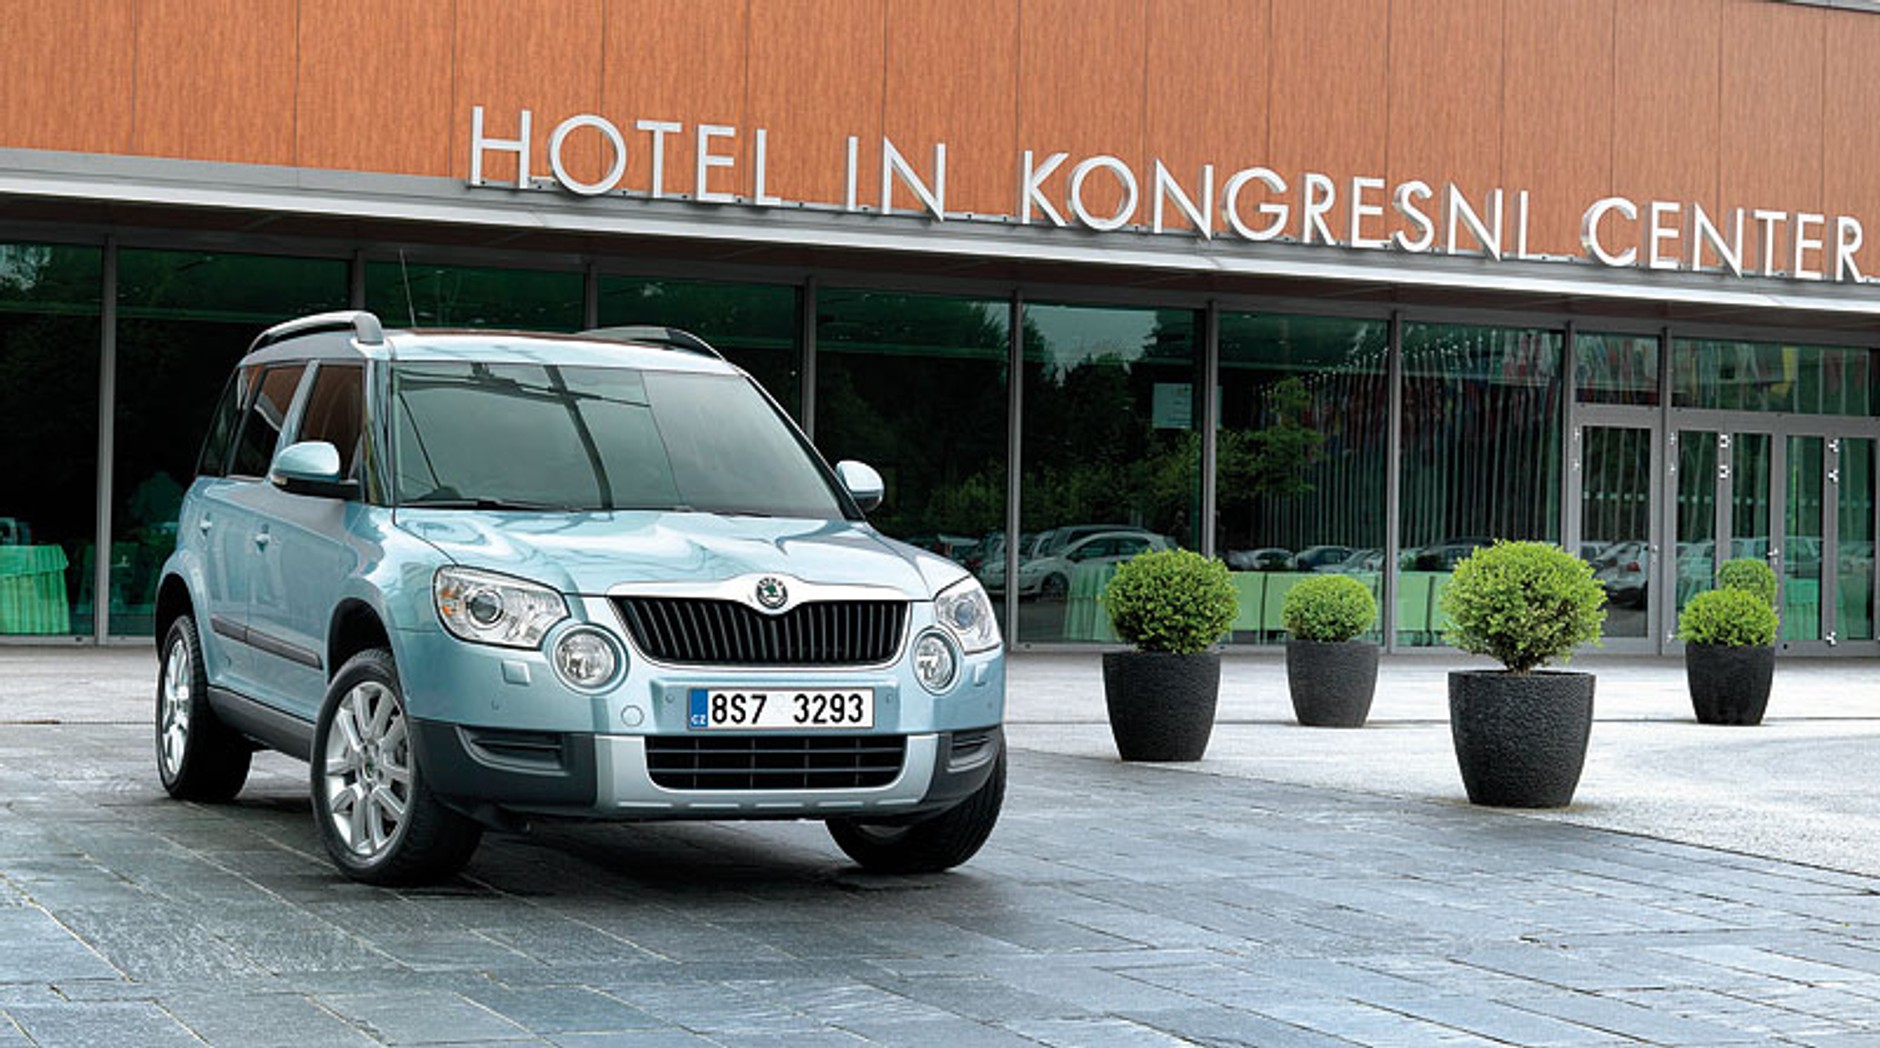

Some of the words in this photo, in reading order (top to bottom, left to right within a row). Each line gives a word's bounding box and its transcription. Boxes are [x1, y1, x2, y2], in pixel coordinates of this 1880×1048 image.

[471, 105, 781, 206] HOTEL
[846, 135, 946, 222] IN
[1584, 197, 1865, 284] CENTER
[690, 714, 706, 726] CZ
[712, 693, 768, 725] 8S7
[793, 693, 864, 724] 3293
